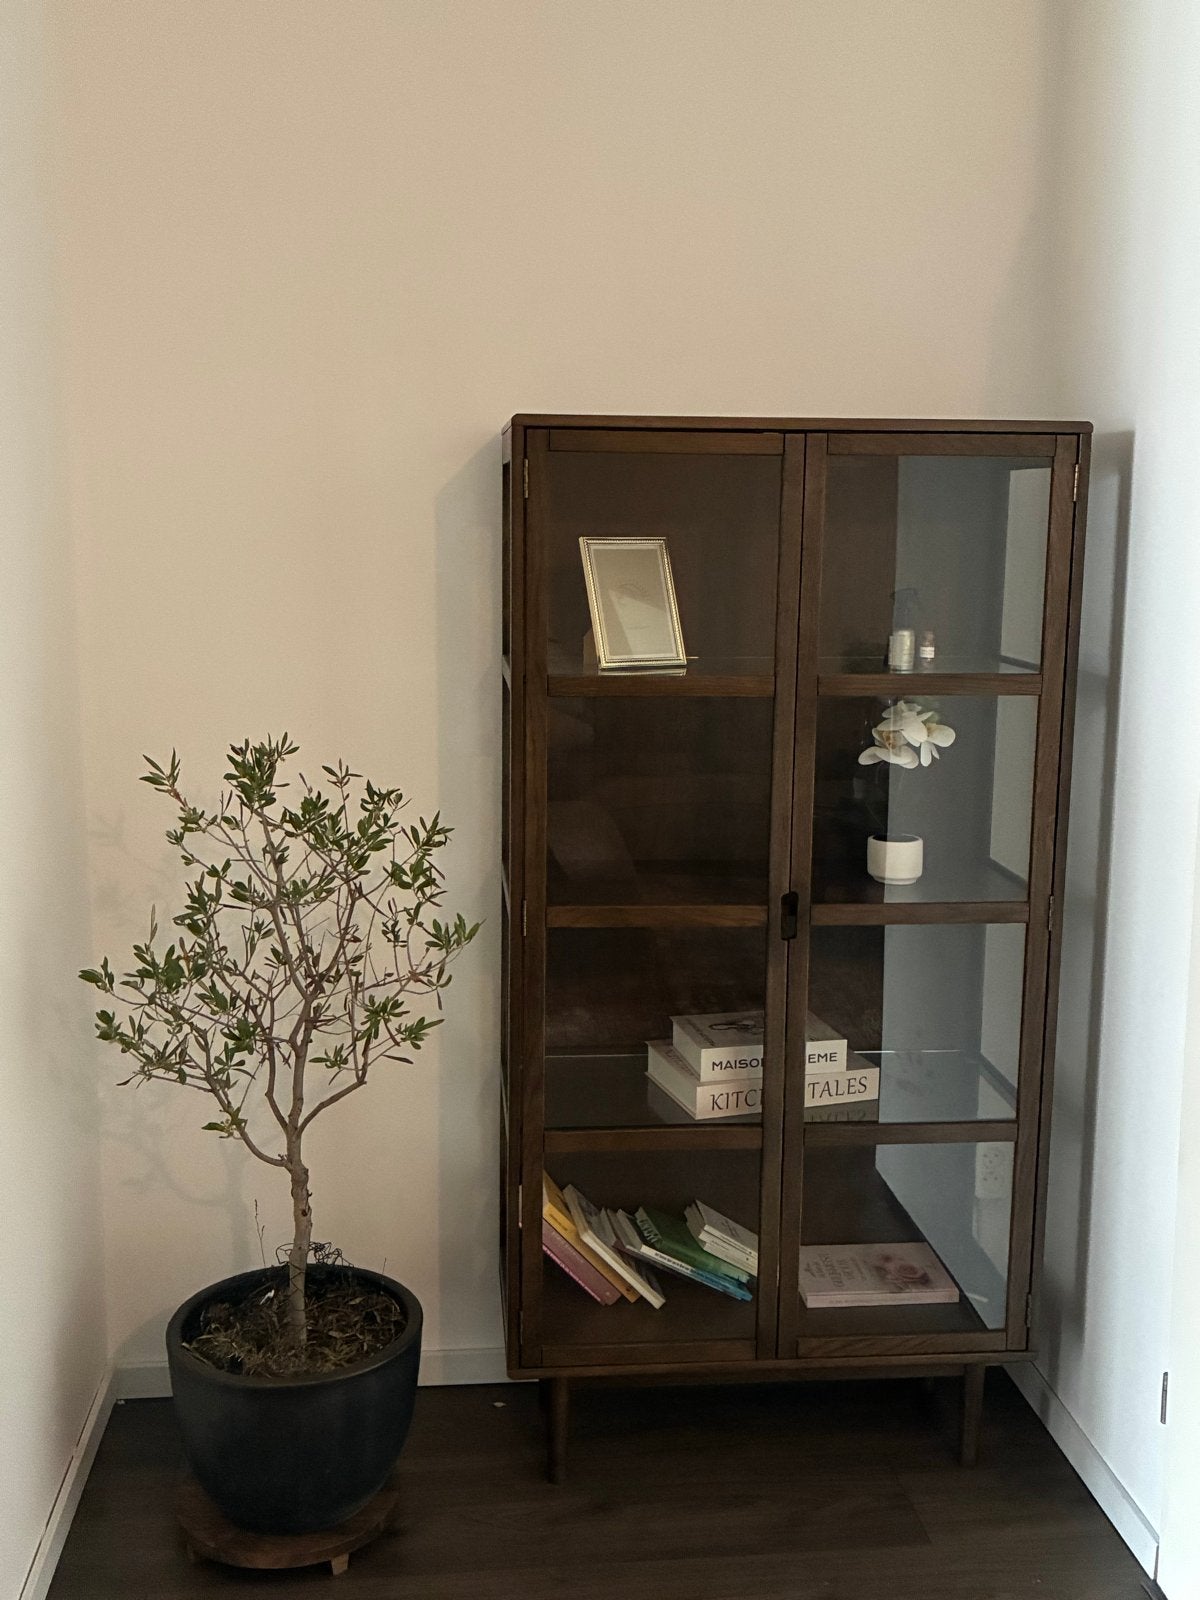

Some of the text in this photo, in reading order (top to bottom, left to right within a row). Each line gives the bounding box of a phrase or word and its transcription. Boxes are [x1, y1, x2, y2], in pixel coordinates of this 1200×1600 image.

[711, 1058, 763, 1072] MAISO
[710, 1076, 868, 1111] KITC TALES
